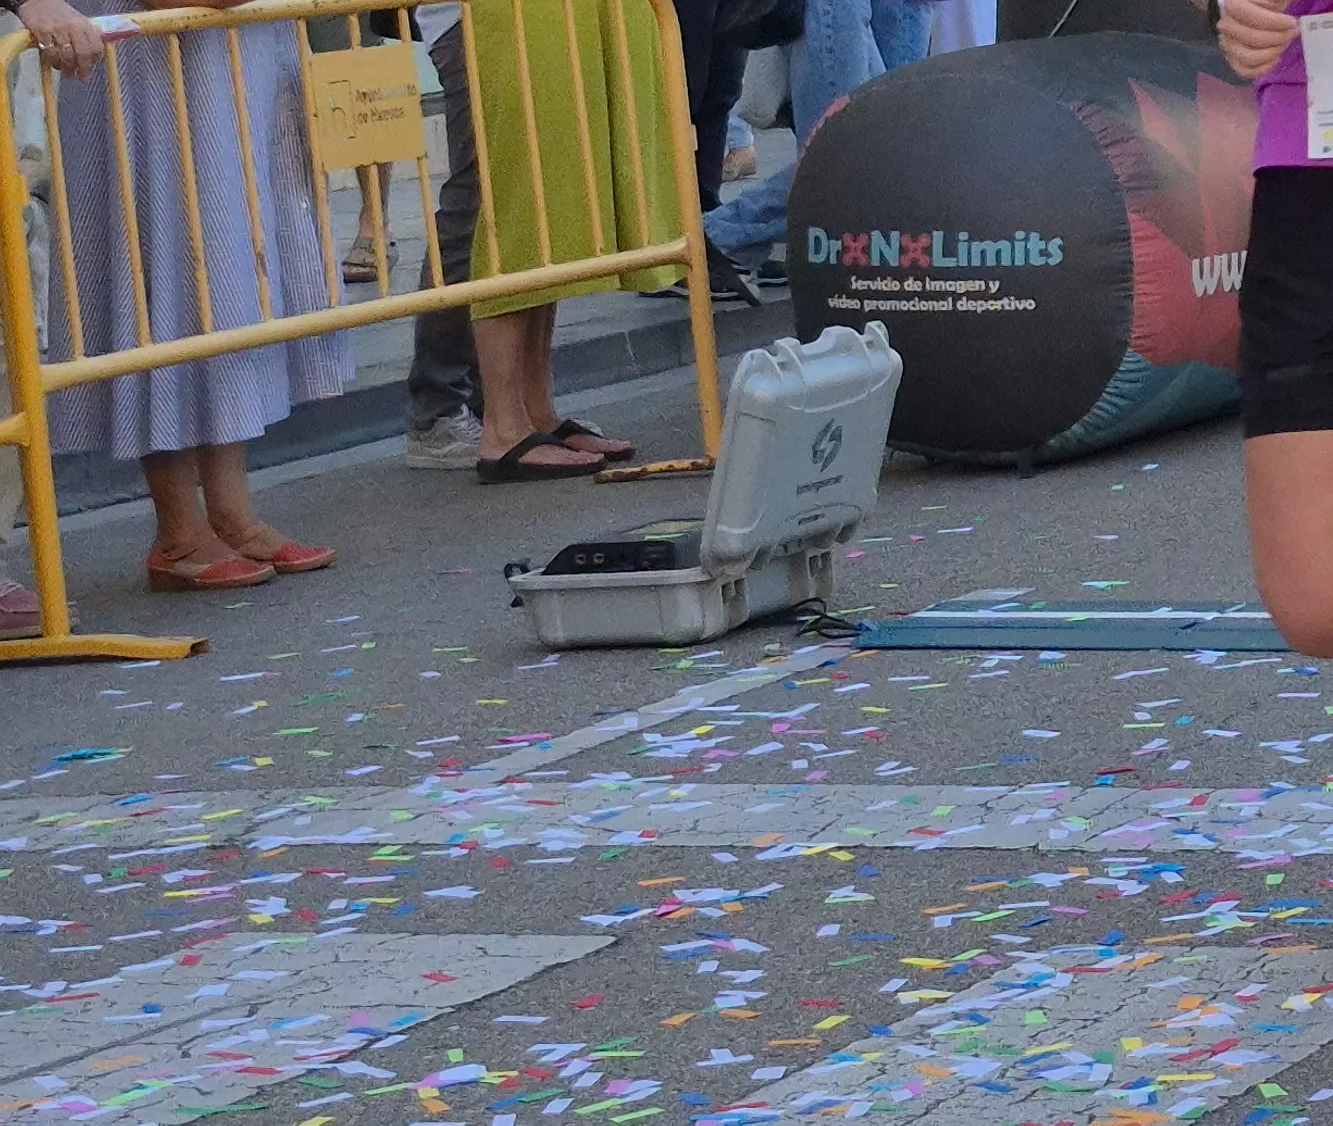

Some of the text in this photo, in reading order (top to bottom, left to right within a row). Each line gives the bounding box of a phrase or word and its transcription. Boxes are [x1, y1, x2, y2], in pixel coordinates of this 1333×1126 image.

[850, 276, 901, 292] Servicio
[903, 276, 923, 292] de
[988, 279, 1000, 294] y
[863, 297, 953, 312] promocional
[957, 295, 1037, 314] deportivo
